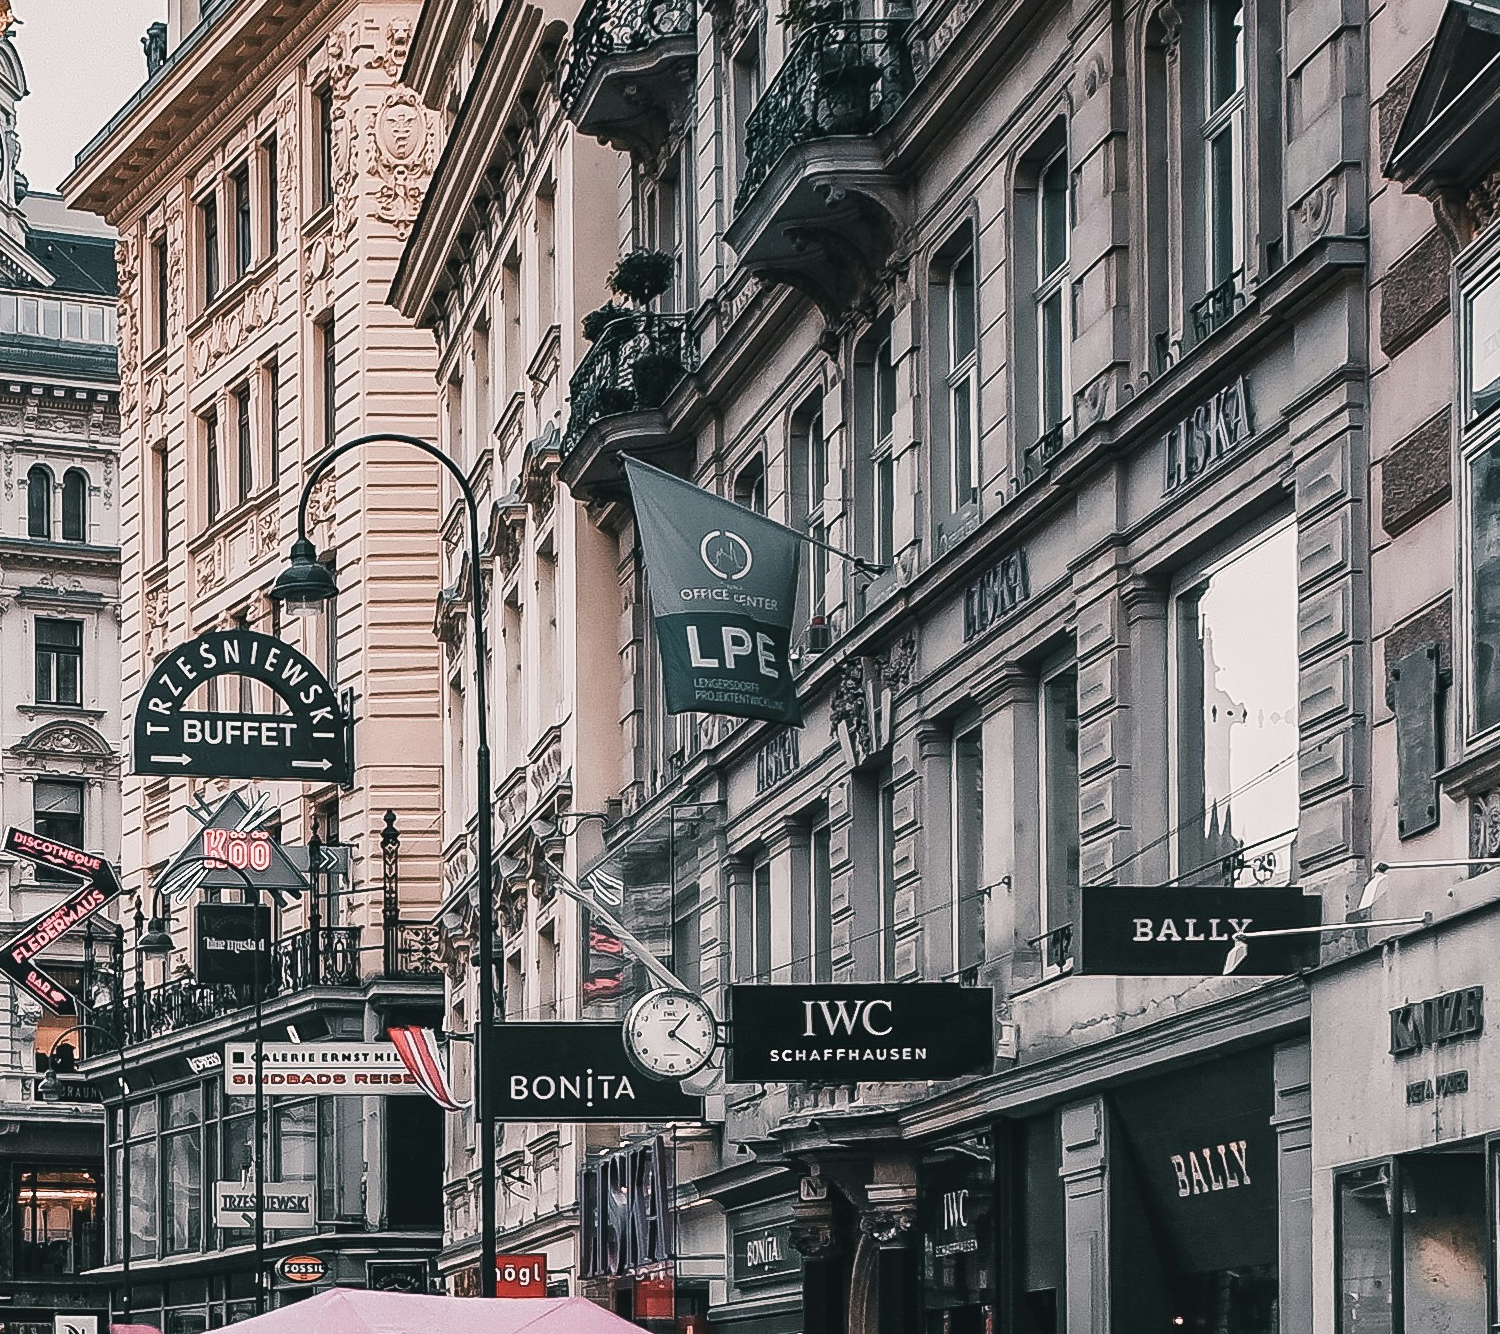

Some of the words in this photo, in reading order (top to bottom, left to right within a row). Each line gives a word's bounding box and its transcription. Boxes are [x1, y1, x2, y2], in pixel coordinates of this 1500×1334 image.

[680, 588, 730, 601] OFFICE
[686, 625, 779, 679] LPE
[183, 719, 297, 747] BUFFET
[14, 832, 102, 870] DISCOTHEQUE
[12, 890, 105, 964] FLEDERMAUS
[1132, 918, 1253, 941] BALLY
[26, 971, 51, 994] BAR
[802, 1000, 893, 1036] IWC
[321, 1052, 369, 1062] ERNST
[375, 1052, 401, 1062] HIL
[770, 1048, 927, 1062] SCHAFFHAUSEN
[1171, 1140, 1252, 1197] BALLY
[221, 1192, 310, 1212] TRZEŚIEWSKI
[284, 1264, 325, 1274] FOSSIL
